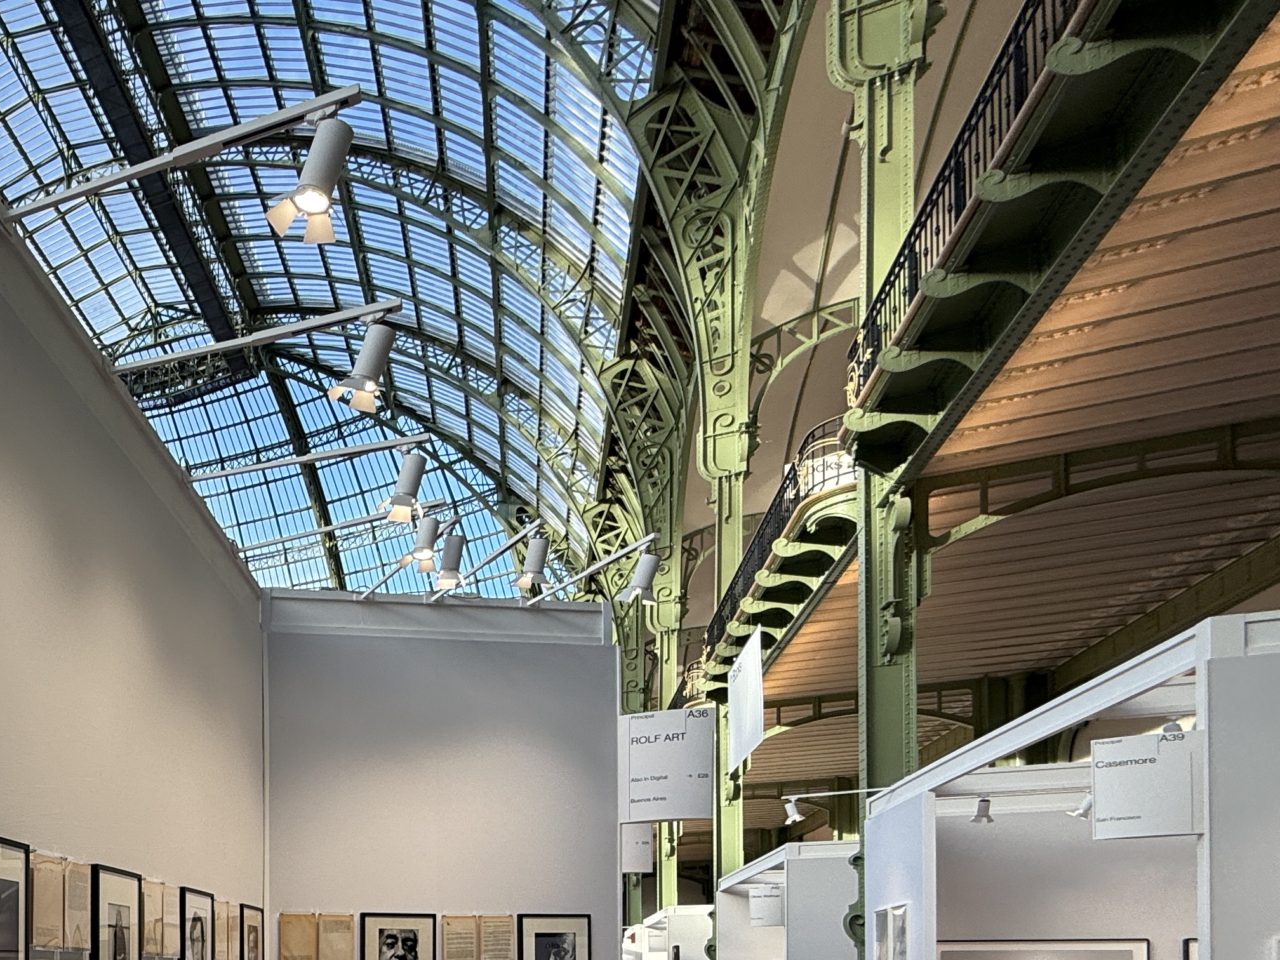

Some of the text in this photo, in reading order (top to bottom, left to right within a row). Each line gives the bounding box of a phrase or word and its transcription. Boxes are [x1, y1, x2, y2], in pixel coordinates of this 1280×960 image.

[687, 709, 709, 719] A36
[631, 732, 686, 746] ROLF ART
[1159, 733, 1185, 742] A39
[1095, 757, 1157, 769] Casemore
